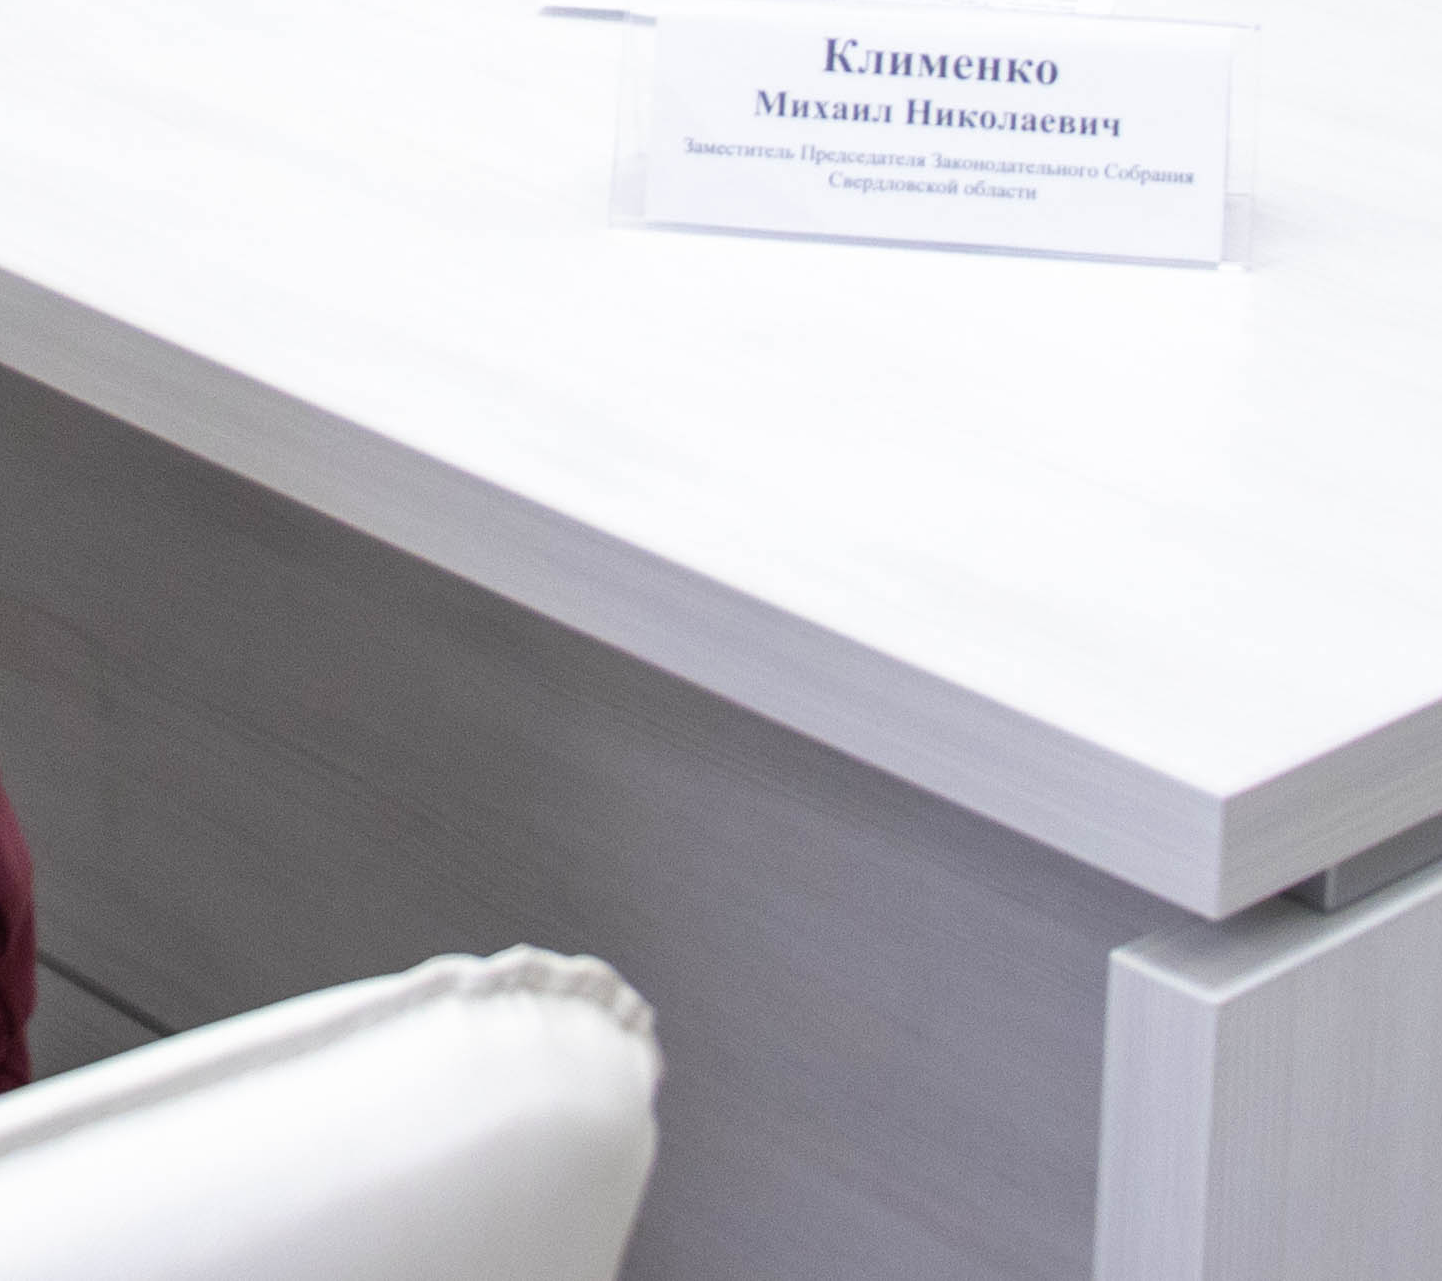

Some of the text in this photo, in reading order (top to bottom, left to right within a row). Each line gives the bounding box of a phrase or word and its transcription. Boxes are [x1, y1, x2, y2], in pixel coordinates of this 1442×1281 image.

[822, 37, 1060, 87] Клименко
[754, 89, 1122, 138] Михаил Николаевич
[684, 137, 1195, 186] Заместитель Председателя Законодательного Собрания
[828, 171, 1038, 201] Свердловской области
